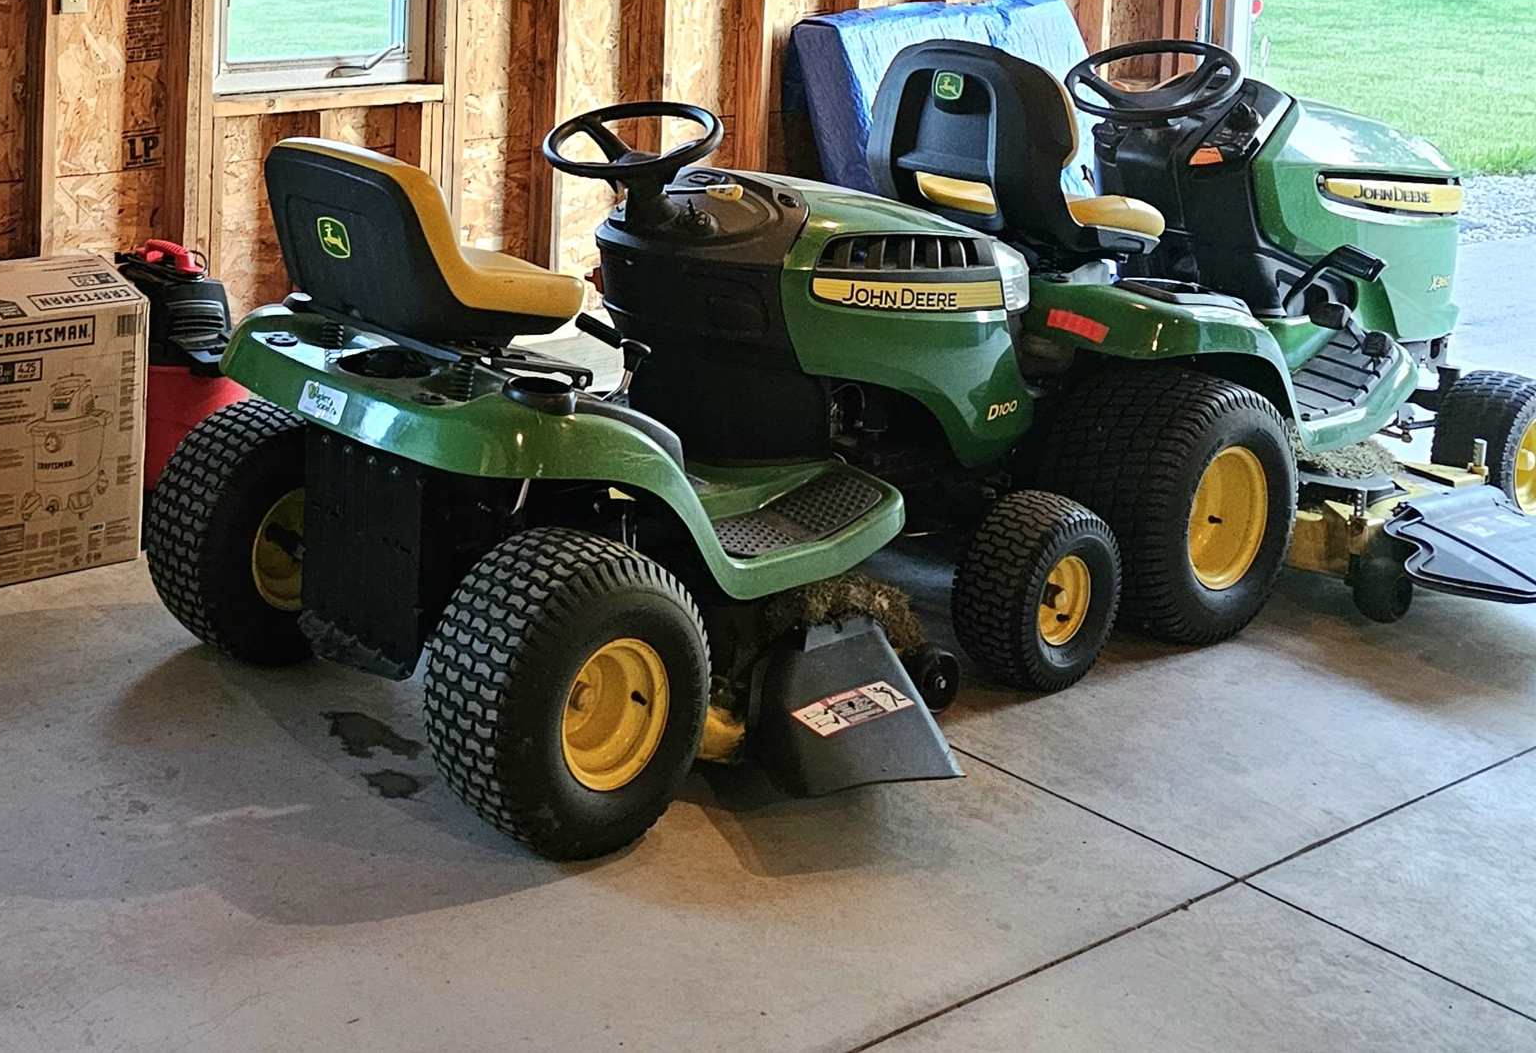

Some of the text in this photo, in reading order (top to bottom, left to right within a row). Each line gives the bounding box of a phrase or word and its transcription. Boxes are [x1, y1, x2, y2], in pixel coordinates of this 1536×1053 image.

[127, 136, 160, 160] LP
[1353, 184, 1431, 203] JOHN DEERE
[38, 288, 131, 307] CRAFTSMAN
[842, 283, 957, 307] JOHN DEERE
[987, 400, 1018, 421] D100
